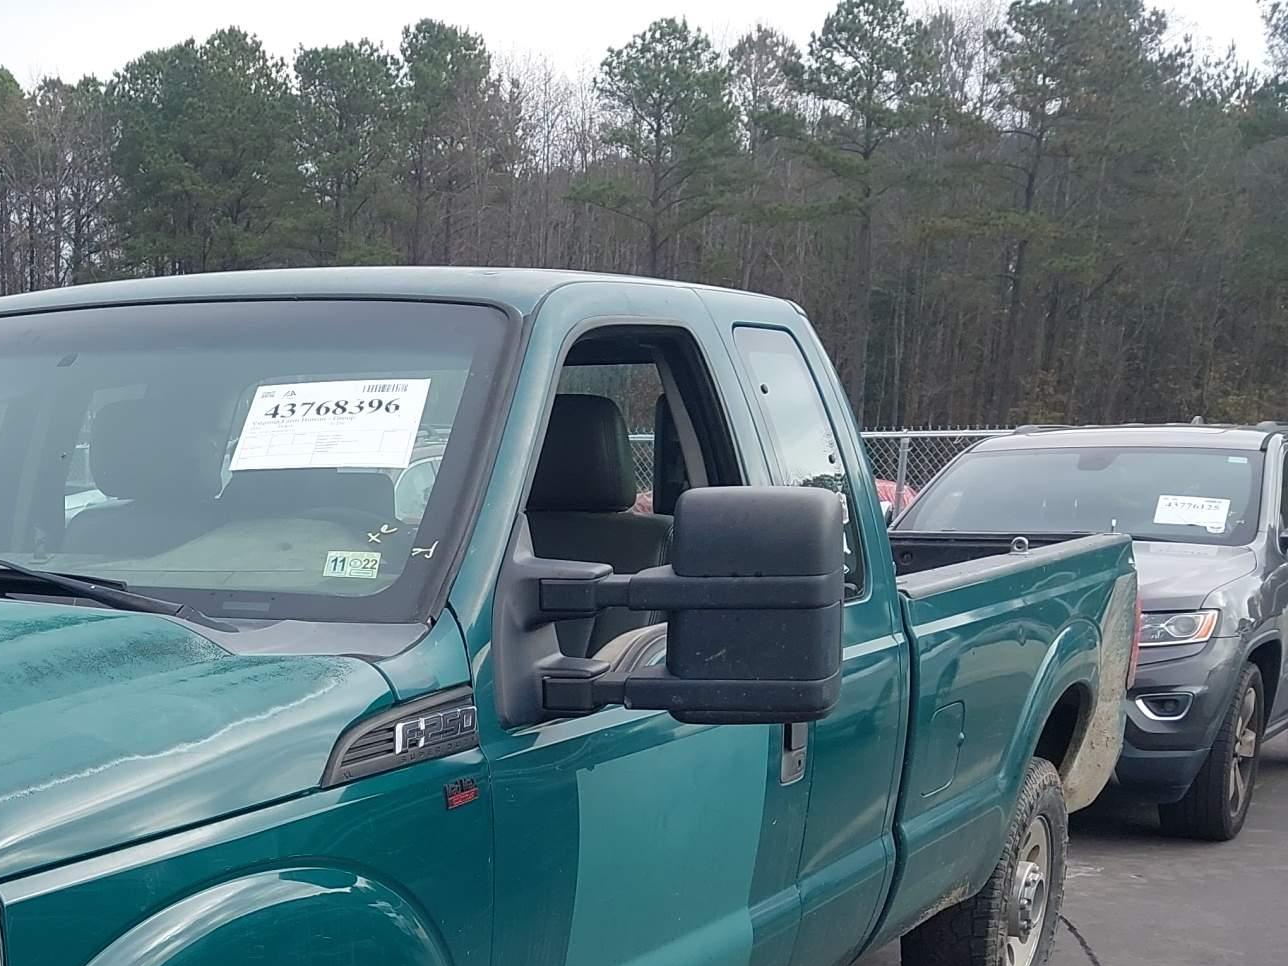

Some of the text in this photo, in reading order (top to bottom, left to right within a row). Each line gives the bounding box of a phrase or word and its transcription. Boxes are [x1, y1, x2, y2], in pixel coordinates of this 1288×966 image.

[264, 398, 400, 418] 43768396
[331, 557, 378, 572] 11 22
